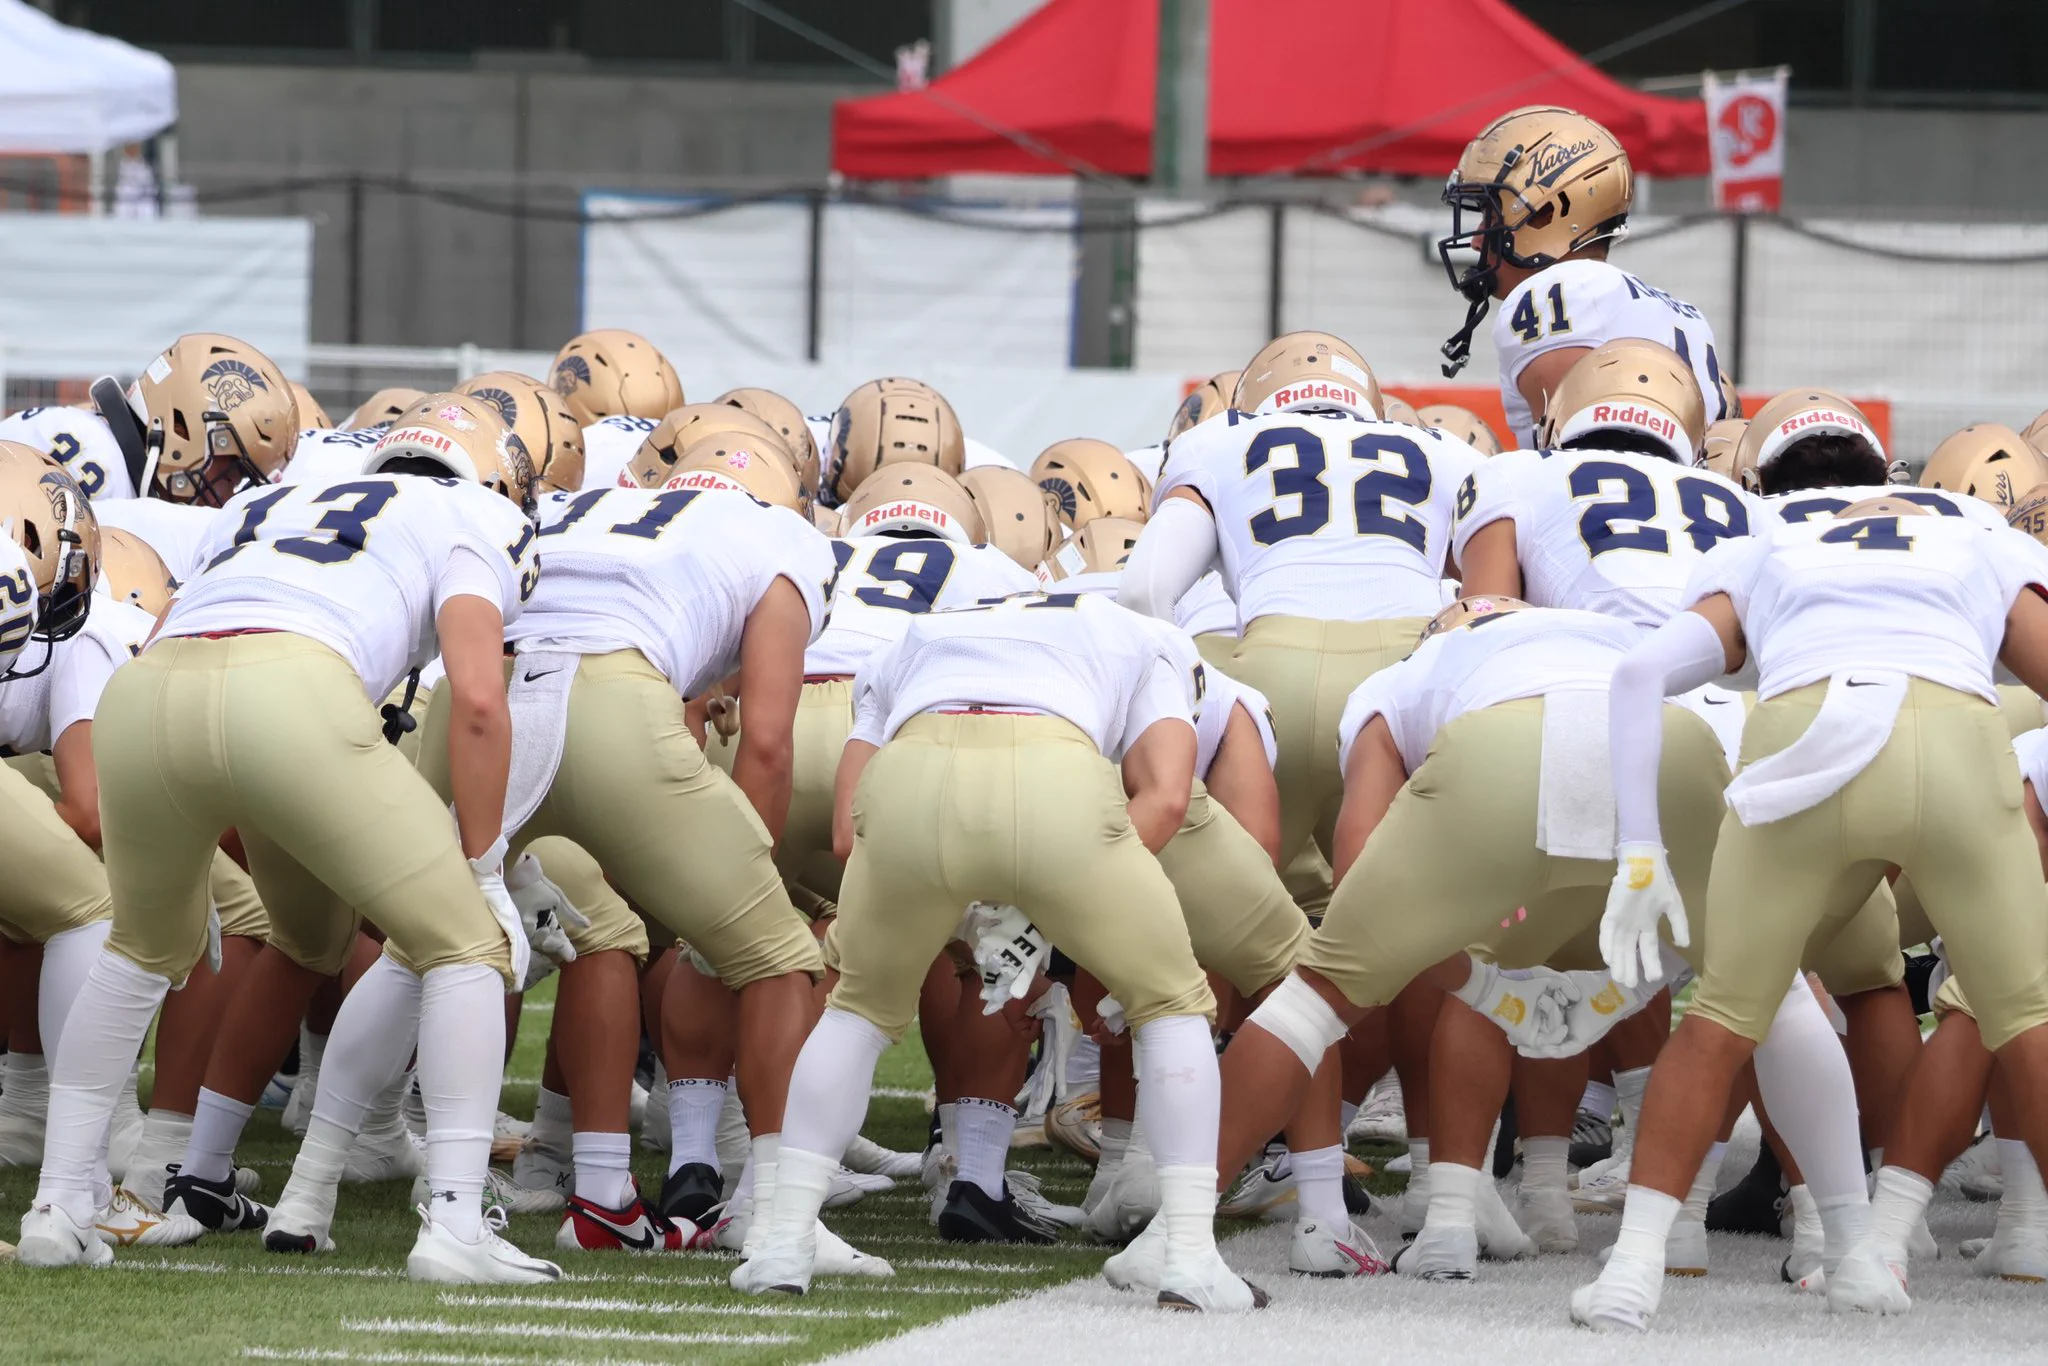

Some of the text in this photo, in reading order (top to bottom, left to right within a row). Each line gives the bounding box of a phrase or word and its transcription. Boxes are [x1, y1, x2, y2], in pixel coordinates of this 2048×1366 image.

[1525, 139, 1598, 188] Kaisers
[1510, 281, 1572, 345] 41
[1275, 384, 1357, 408] Riddell
[374, 429, 452, 453] Riddell
[1593, 405, 1676, 441] Riddell
[1780, 411, 1864, 436] Riddell
[1244, 426, 1433, 557] 32
[1568, 461, 1751, 560] 28
[200, 480, 400, 575] 13
[537, 488, 703, 541] 11
[865, 504, 947, 528] Riddell
[2020, 511, 2046, 534] 35
